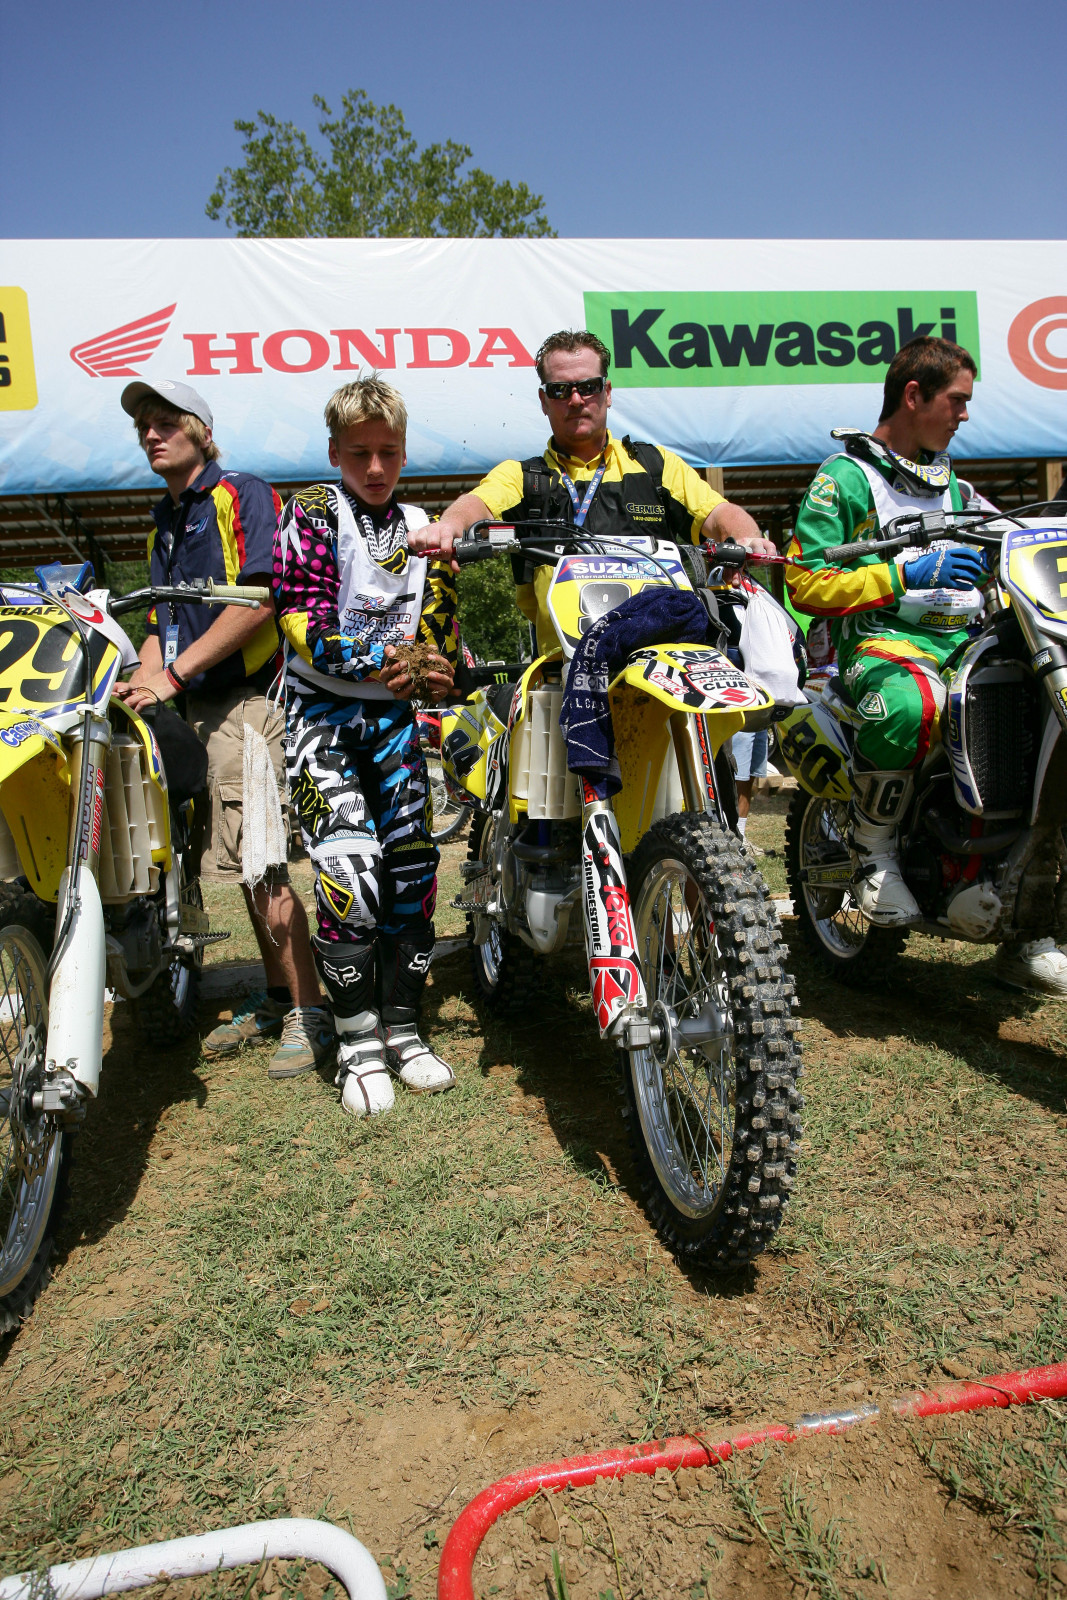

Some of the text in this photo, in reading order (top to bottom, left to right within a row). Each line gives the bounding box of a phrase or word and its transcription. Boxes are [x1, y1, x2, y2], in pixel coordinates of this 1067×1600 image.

[610, 307, 959, 369] Kawasaki
[184, 327, 536, 376] HONDA
[572, 562, 667, 576] SUZUKI
[0, 606, 64, 616] CRAF
[920, 614, 969, 626] CONTROL
[688, 663, 732, 672] MOTUL
[690, 670, 743, 681] SUZUK
[702, 682, 750, 691] CLUB
[822, 869, 852, 881] SUNLIN
[583, 855, 602, 951] BRIDGESTONE
